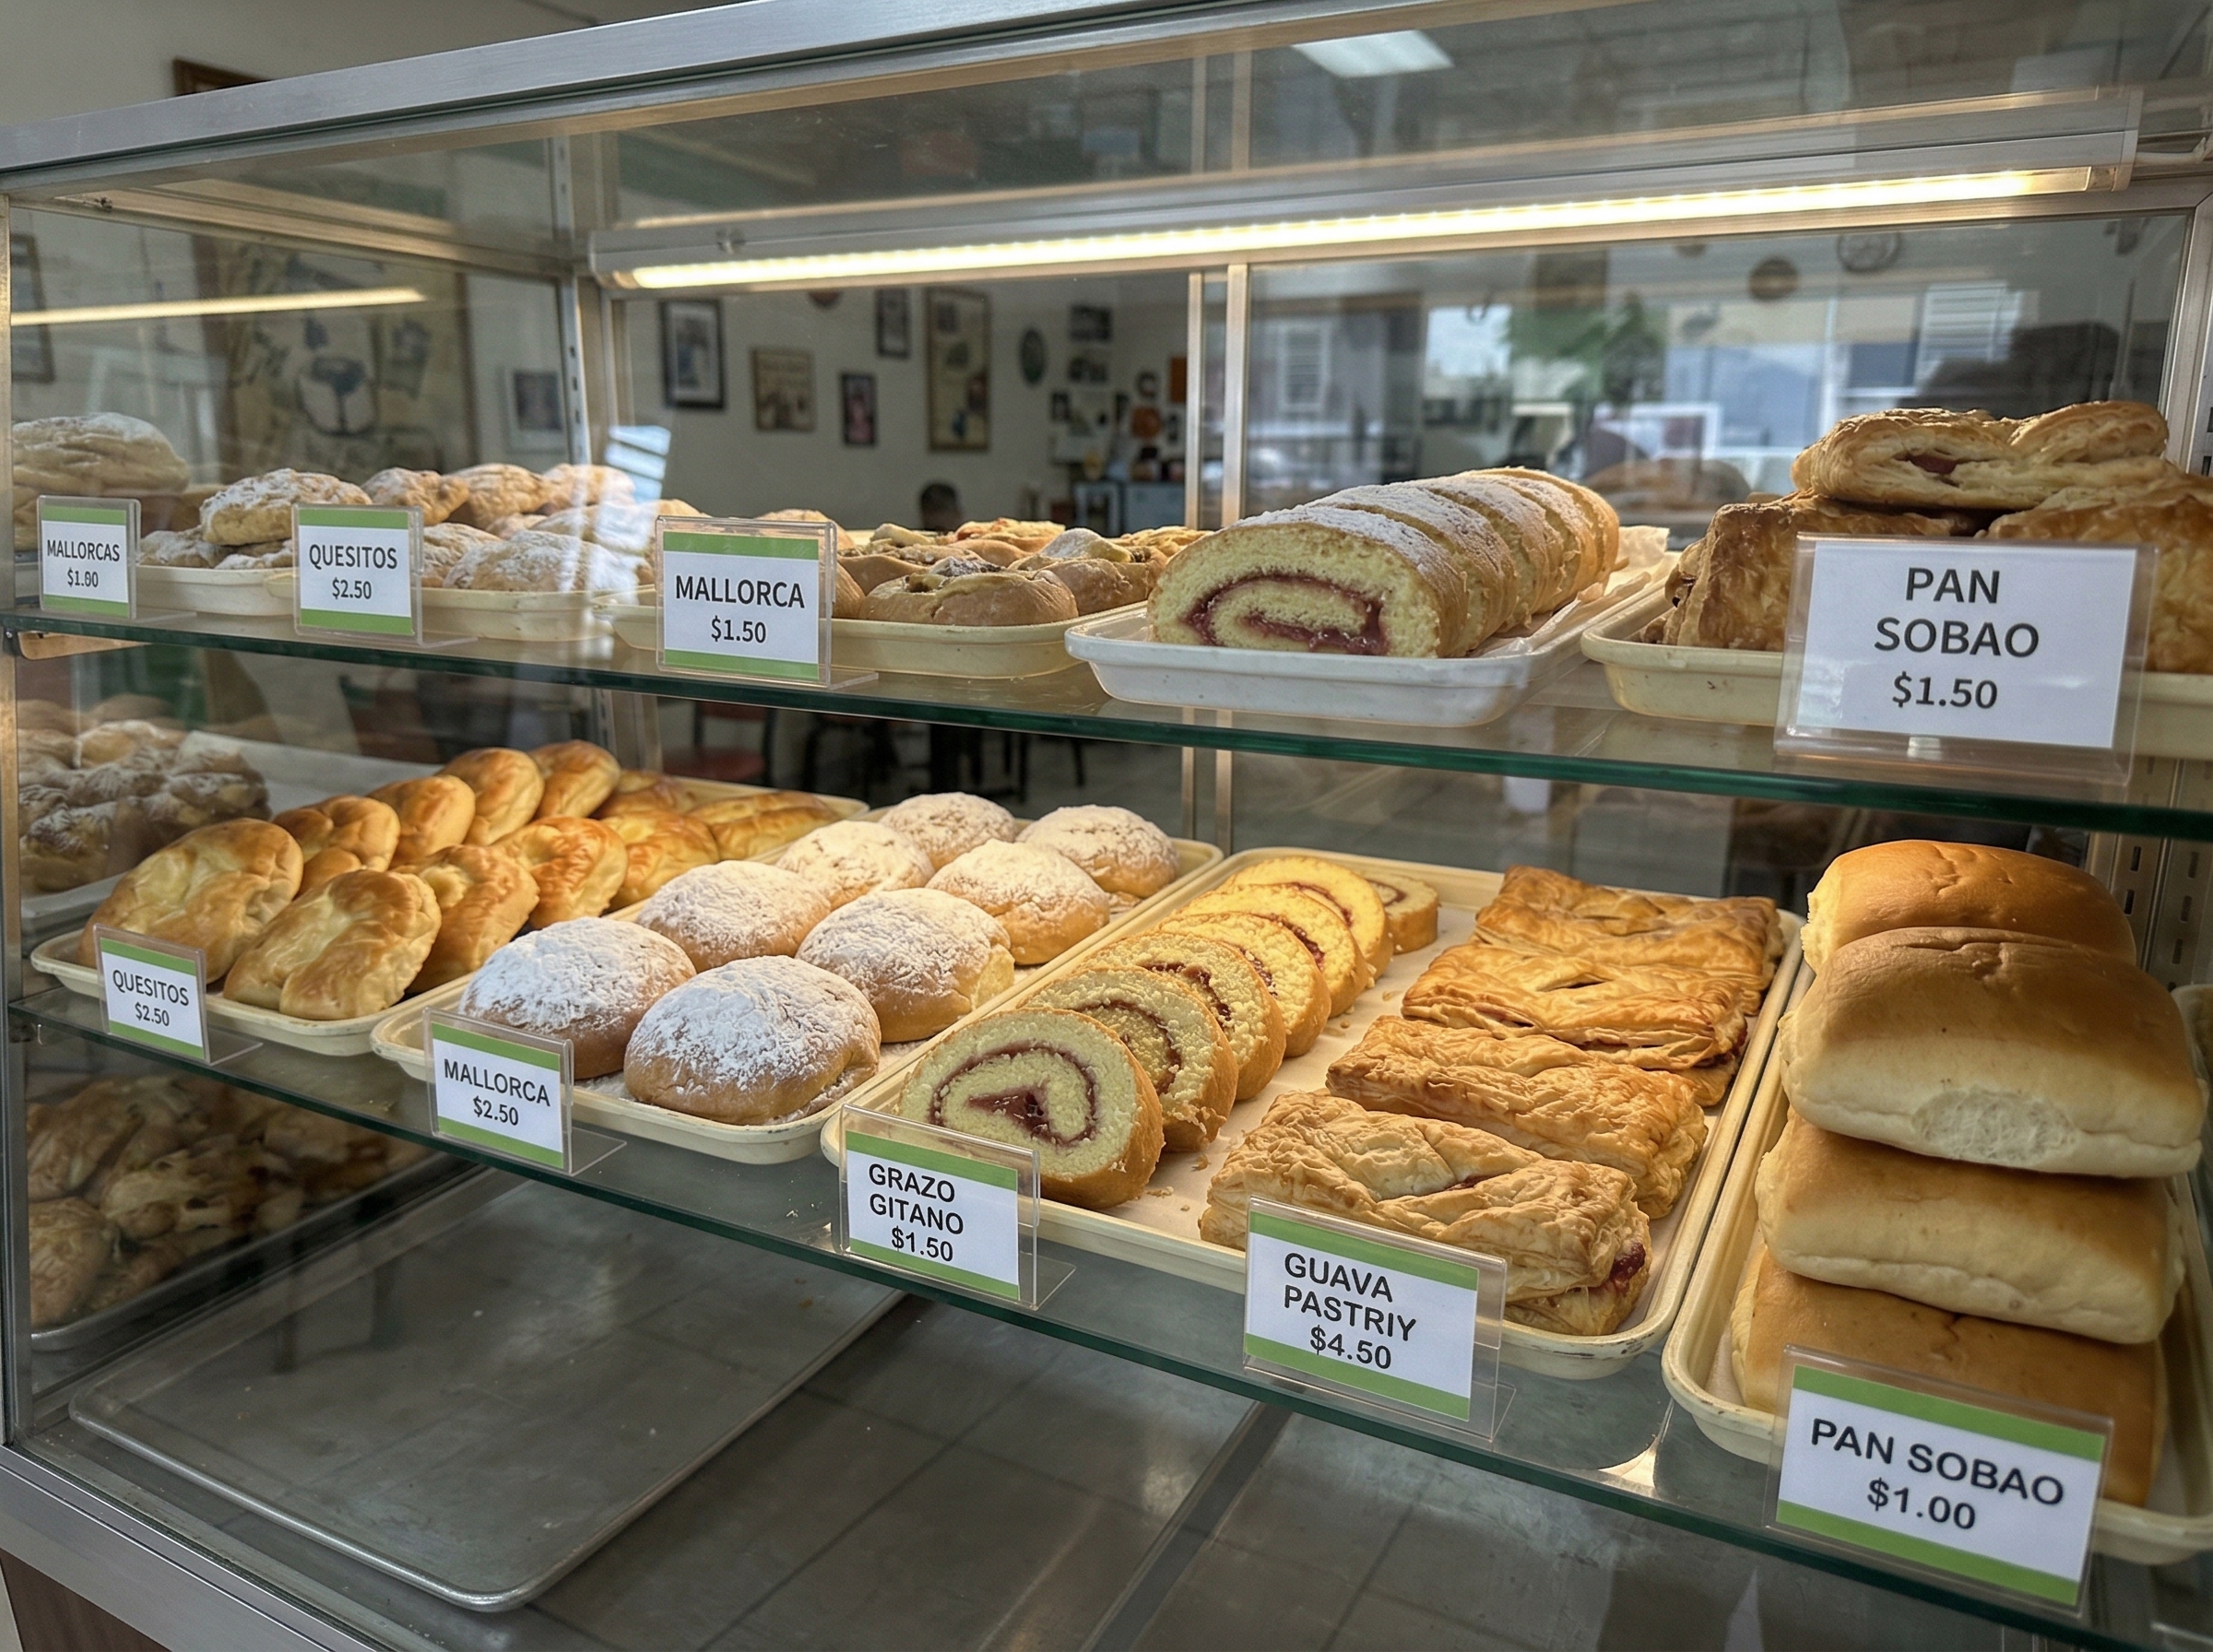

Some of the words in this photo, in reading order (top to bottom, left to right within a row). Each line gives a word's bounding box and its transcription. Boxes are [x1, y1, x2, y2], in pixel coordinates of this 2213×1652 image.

[47, 539, 121, 562] MALLORCAS
[309, 544, 397, 571] QUESITOS
[332, 577, 373, 600] $2.50
[676, 574, 805, 610] MALLORCA
[1905, 566, 2001, 605] PAN
[711, 614, 766, 643] $1.50
[1874, 616, 2040, 659] SOBAO
[1891, 670, 1999, 710] $1.50
[112, 969, 190, 1006] QUESITOS
[135, 1001, 170, 1027] $2.50
[444, 1058, 550, 1108] MALLORCA
[472, 1094, 519, 1127] $2.50
[869, 1162, 955, 1204] GRAZO
[870, 1192, 964, 1236] GITANO
[891, 1224, 953, 1264] $1.50
[1284, 1252, 1393, 1304] GUAVA
[1284, 1284, 1417, 1343] PASTRIY
[1309, 1324, 1392, 1371] $4.50
[1811, 1417, 1895, 1466] PAN
[1907, 1442, 2065, 1507] SOBAO
[1866, 1475, 1977, 1531] $1.00
